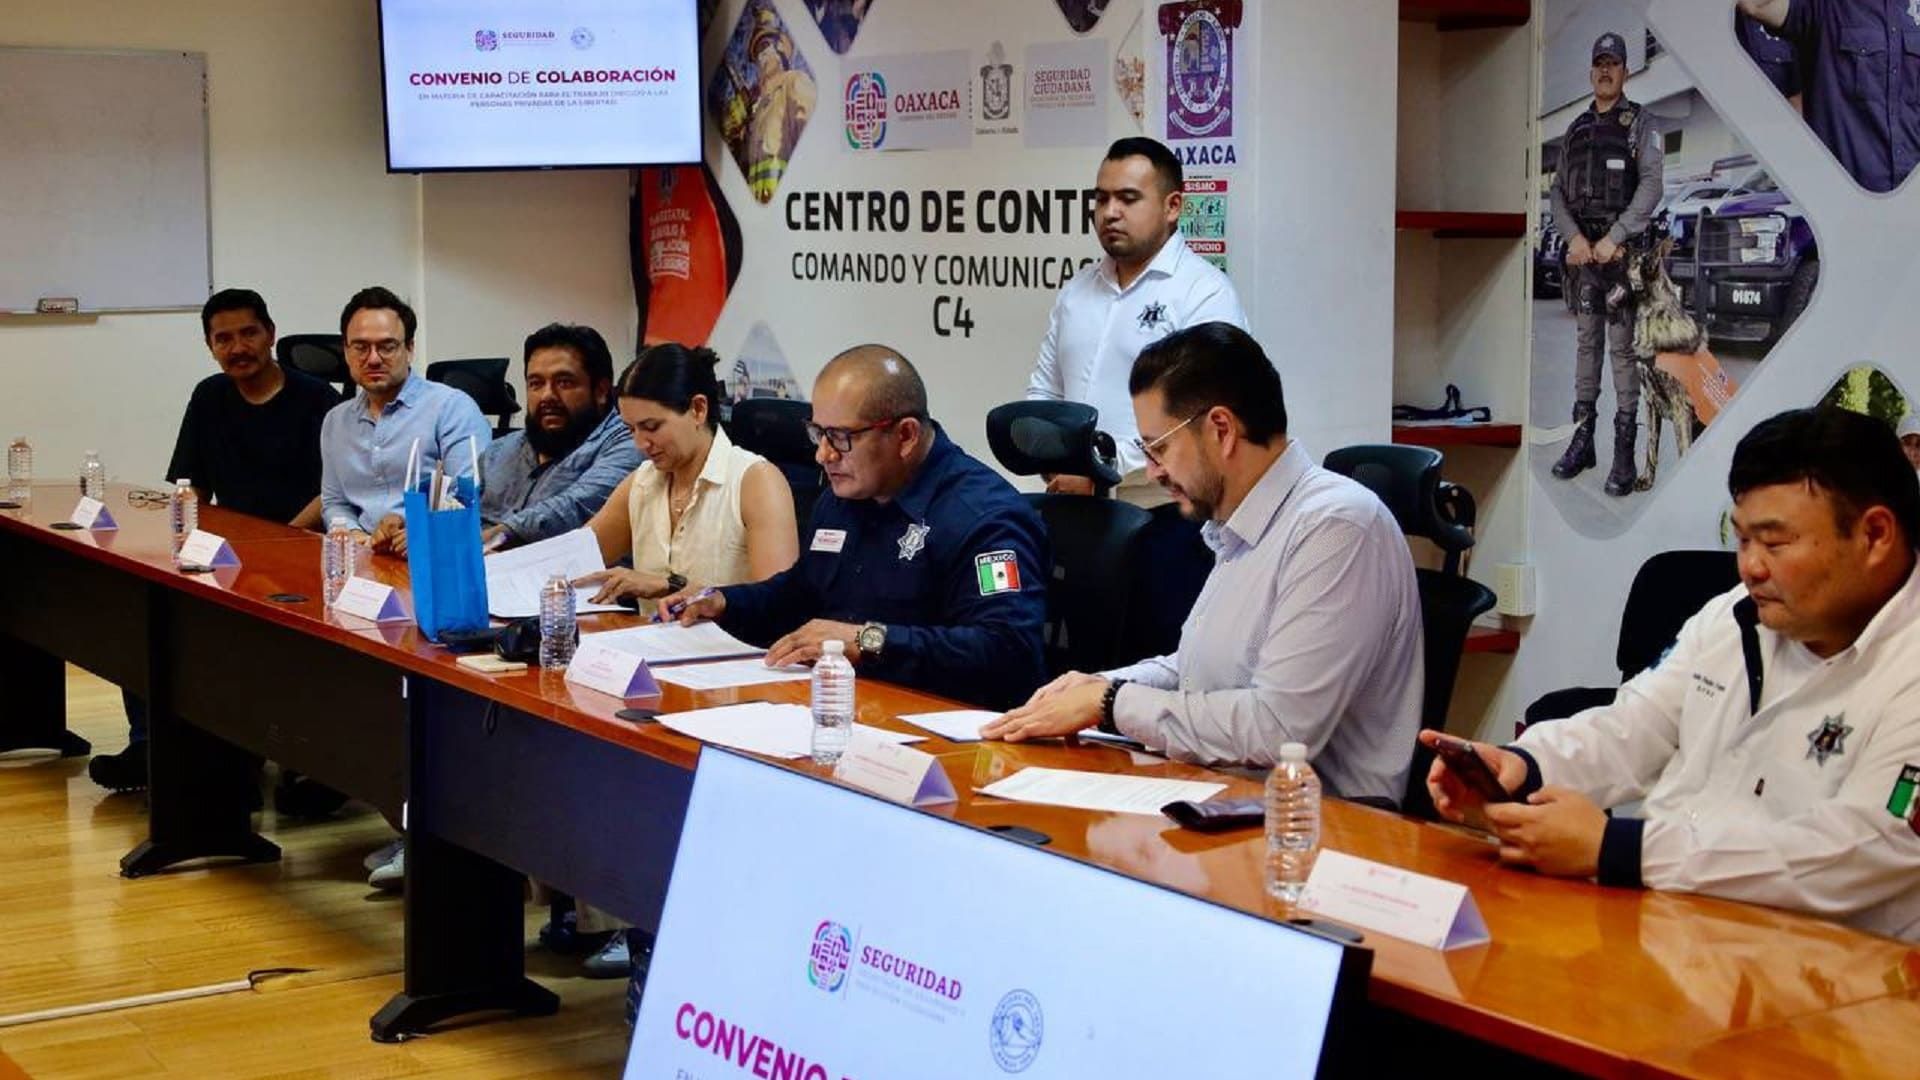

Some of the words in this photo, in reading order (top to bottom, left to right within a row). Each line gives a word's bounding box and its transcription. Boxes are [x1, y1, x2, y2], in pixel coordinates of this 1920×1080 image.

[502, 31, 555, 39] SEGURIDAD
[409, 72, 503, 86] CONVENIO
[508, 71, 531, 84] DE
[536, 66, 676, 84] COLABORACIÓN
[1034, 69, 1091, 82] SEGURIDAD
[1033, 81, 1092, 95] CIUDADANA
[895, 89, 960, 113] OAXACA
[1174, 145, 1237, 166] AXACA
[1184, 181, 1216, 192] SISMO
[785, 190, 910, 232] CENTRO
[921, 190, 966, 233] DE
[976, 189, 1096, 234] CONTR
[1186, 243, 1222, 252] CENDIO
[792, 252, 906, 284] COMANDO
[912, 254, 928, 285] Y
[934, 255, 1094, 289] COMUNICA
[933, 296, 975, 338] C4
[860, 945, 962, 1001] SEGURIDAD
